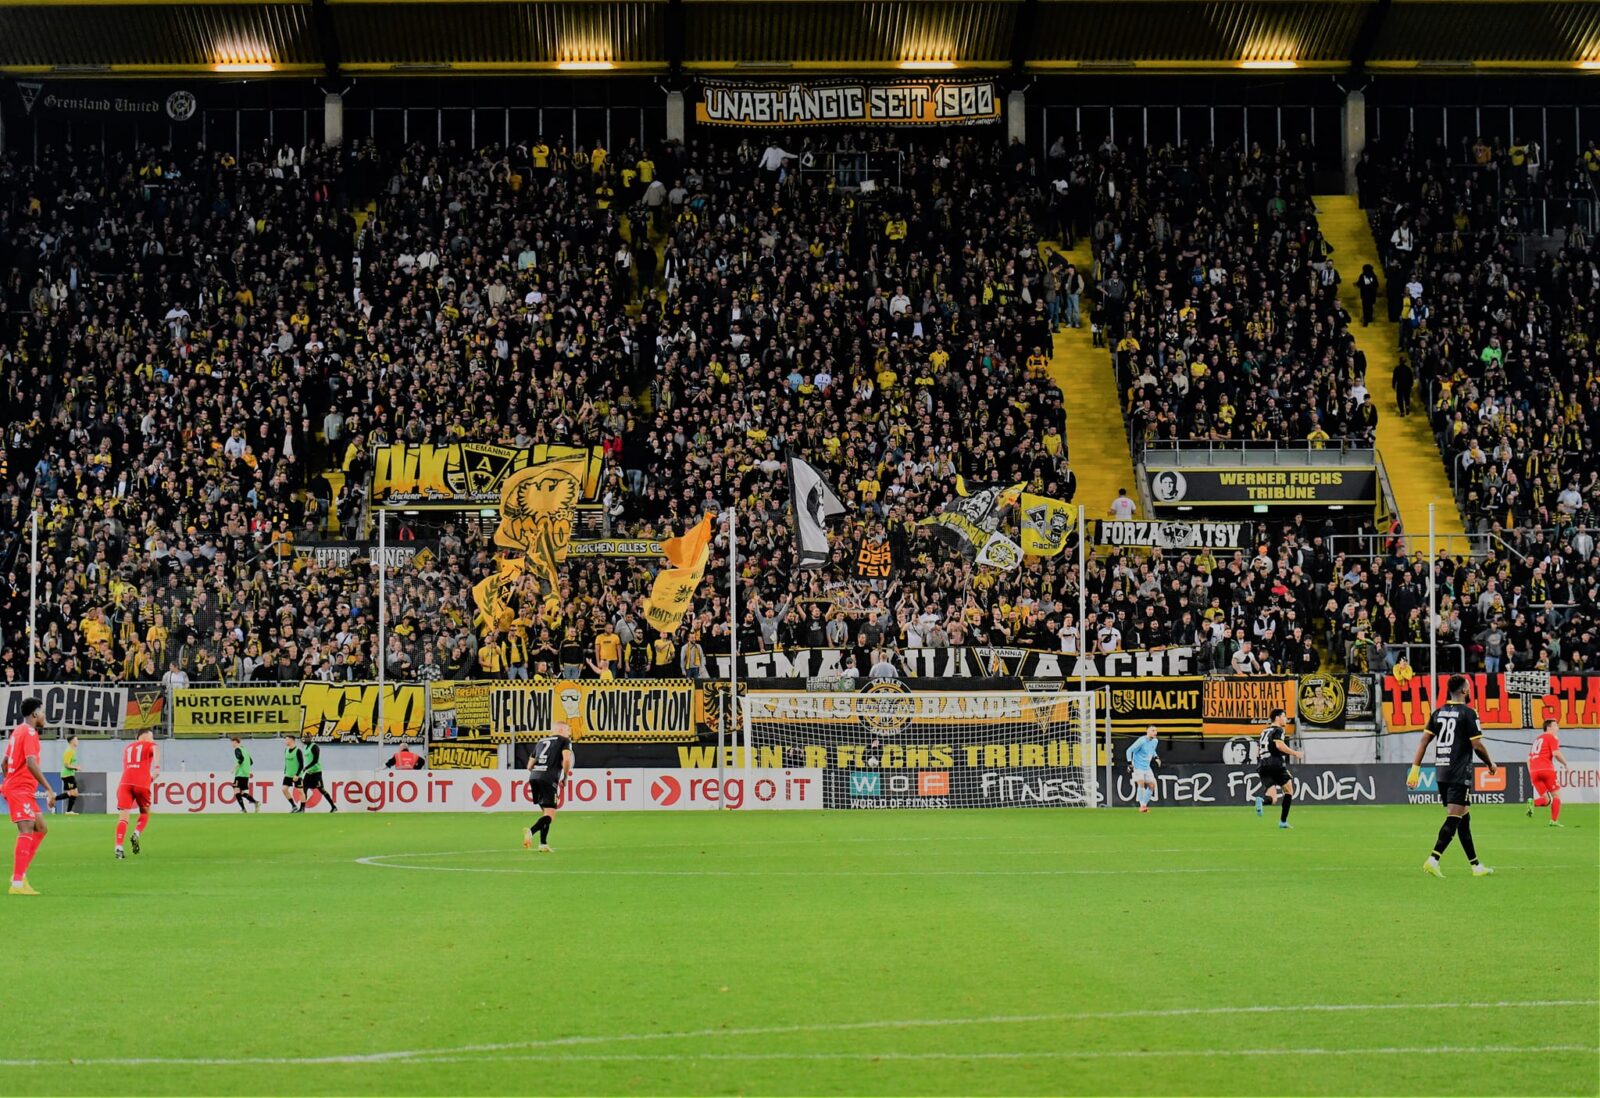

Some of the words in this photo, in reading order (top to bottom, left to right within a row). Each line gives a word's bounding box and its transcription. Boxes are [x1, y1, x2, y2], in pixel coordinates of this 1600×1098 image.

[44, 94, 110, 111] Grenzland
[115, 98, 159, 112] United
[705, 85, 864, 121] UNABHÄNGIG
[870, 87, 928, 119] SEIT
[935, 83, 994, 117] 1900
[464, 443, 511, 457] ALEMANNIA
[1219, 472, 1286, 485] WERNER
[1290, 472, 1343, 485] FUCHS
[1247, 485, 1316, 500] TRIBÜNE
[1101, 523, 1160, 546] FORZA
[1191, 523, 1241, 547] ATSV
[576, 543, 615, 554] AACHEN
[618, 542, 647, 553] ALLES
[859, 551, 892, 565] DER
[858, 563, 892, 577] TSV
[1034, 647, 1193, 677] AACHE
[1136, 690, 1200, 710] WACHT
[1203, 681, 1286, 699] REUNDSCHAFT
[176, 694, 300, 707] HÜRTGENWALD
[491, 689, 552, 732] YELLOW
[586, 689, 691, 731] CONNECTION
[191, 710, 289, 725] RUREIFEL
[1436, 717, 1456, 747] 28
[126, 744, 143, 764] 11
[432, 747, 491, 768] HALTUNG
[538, 740, 551, 759] 2
[677, 746, 827, 768] WERNR
[606, 771, 632, 801] iT
[1117, 772, 1215, 801] UTER
[1559, 767, 1600, 788] ÜCHE
[331, 772, 418, 811] regio
[427, 772, 453, 802] iT
[690, 778, 776, 809] rego
[785, 771, 811, 800] iT
[1469, 793, 1505, 804] ITNESS
[851, 799, 886, 809] WORLD
[906, 798, 948, 808] FITNESS
